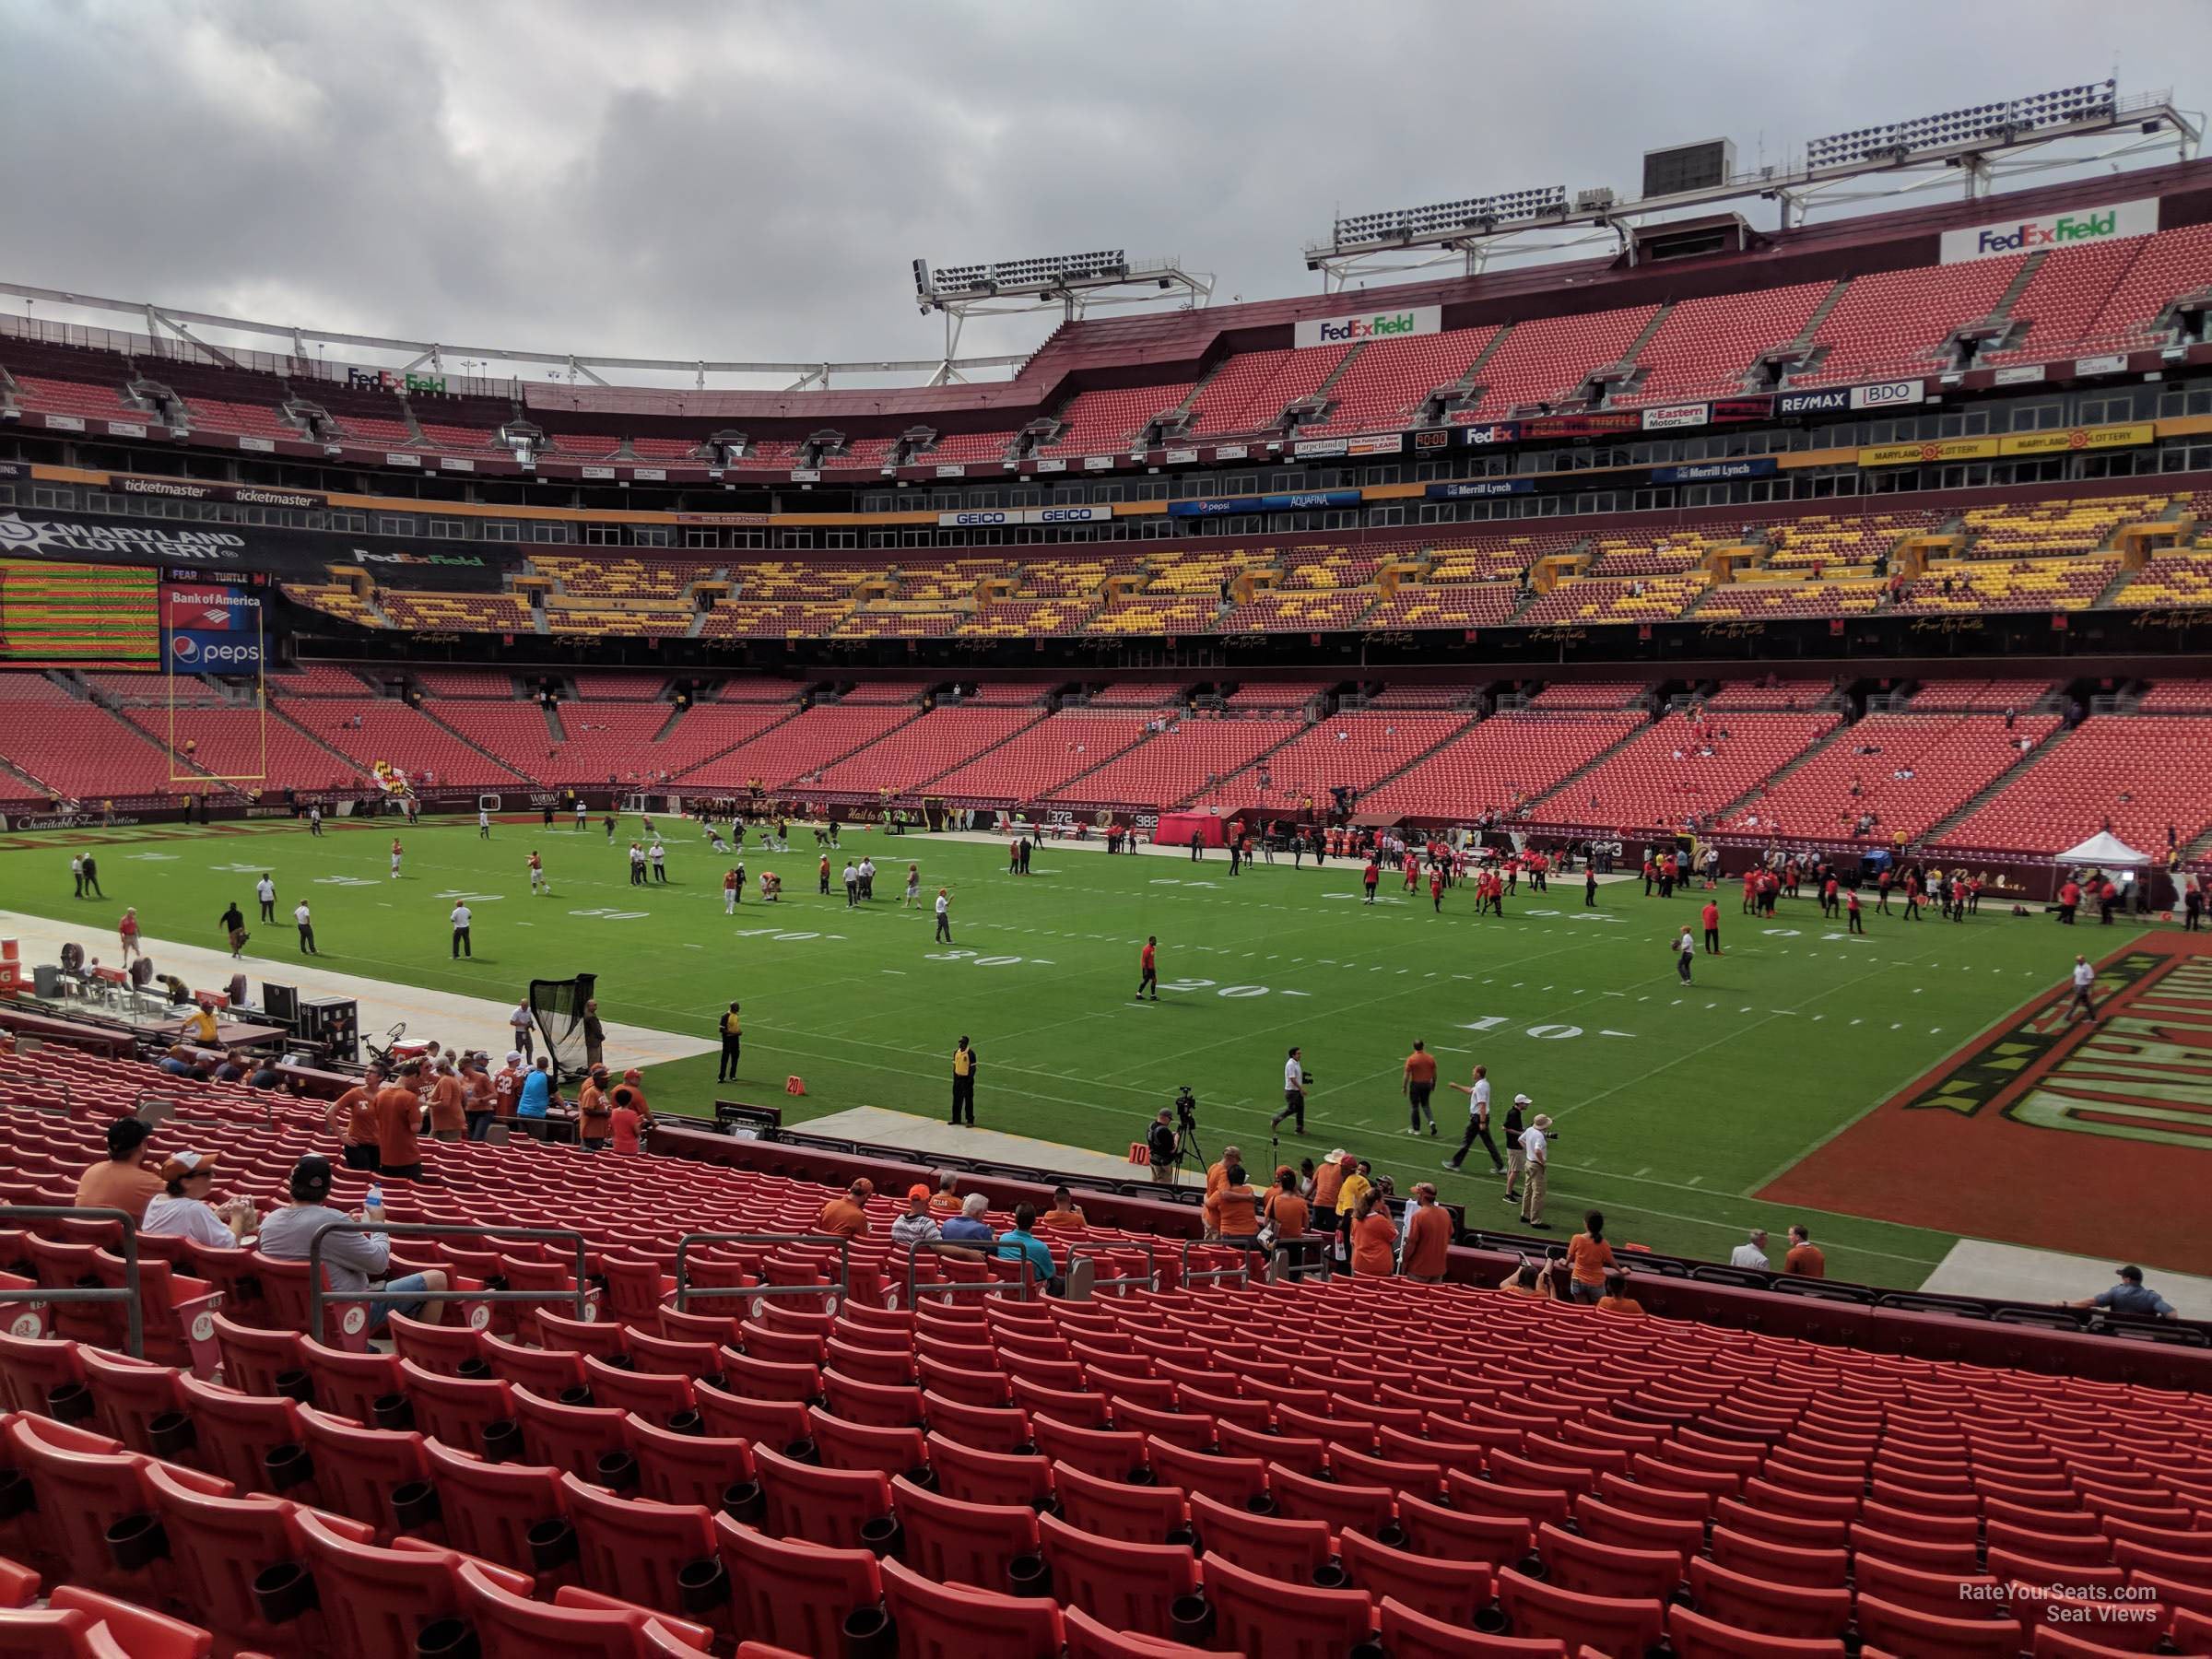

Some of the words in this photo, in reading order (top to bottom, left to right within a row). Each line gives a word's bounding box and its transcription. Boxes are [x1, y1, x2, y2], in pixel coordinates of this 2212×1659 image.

[1979, 210, 2116, 253] FedExField
[1321, 312, 1414, 342] FedExField
[348, 367, 446, 394] FedExField
[1868, 383, 1910, 401] BDO
[1781, 394, 1844, 412] RE/MAX
[1466, 425, 1513, 444] FedEx
[2017, 438, 2066, 449] MARYLAND
[2089, 431, 2132, 443] LOTTERY
[1297, 441, 1336, 452] Carpetland
[1874, 450, 1920, 461] MARYLAND
[1941, 444, 1979, 455] LOTTERY
[1689, 466, 1722, 478] Merrill
[1722, 463, 1750, 477] Lynch
[124, 479, 206, 498] ticketmaster
[235, 488, 312, 507] ticketmaster
[1458, 485, 1487, 496] Merrill
[1487, 482, 1512, 495] Lynch
[1208, 500, 1230, 512] pepsi
[1290, 494, 1328, 508] AQUAFINA
[957, 512, 1006, 524] GEICO
[1041, 508, 1092, 523] GEICO
[53, 523, 245, 547] MARYLAND
[65, 535, 220, 559] LOTTERY
[353, 548, 486, 567] FedExField
[171, 592, 202, 605] Bank
[202, 594, 215, 605] of
[215, 594, 261, 607] America
[204, 645, 264, 665] peps
[17, 816, 78, 830] Charitable
[848, 807, 868, 821] Hail
[569, 908, 650, 920] 50
[924, 949, 1023, 966] 30
[0, 971, 11, 982] G
[1157, 977, 1271, 997] 20
[1453, 1015, 1584, 1040] 10
[497, 1075, 513, 1095] 32
[787, 1077, 799, 1094] 20
[358, 1100, 369, 1111] T
[1129, 1145, 1147, 1164] 10
